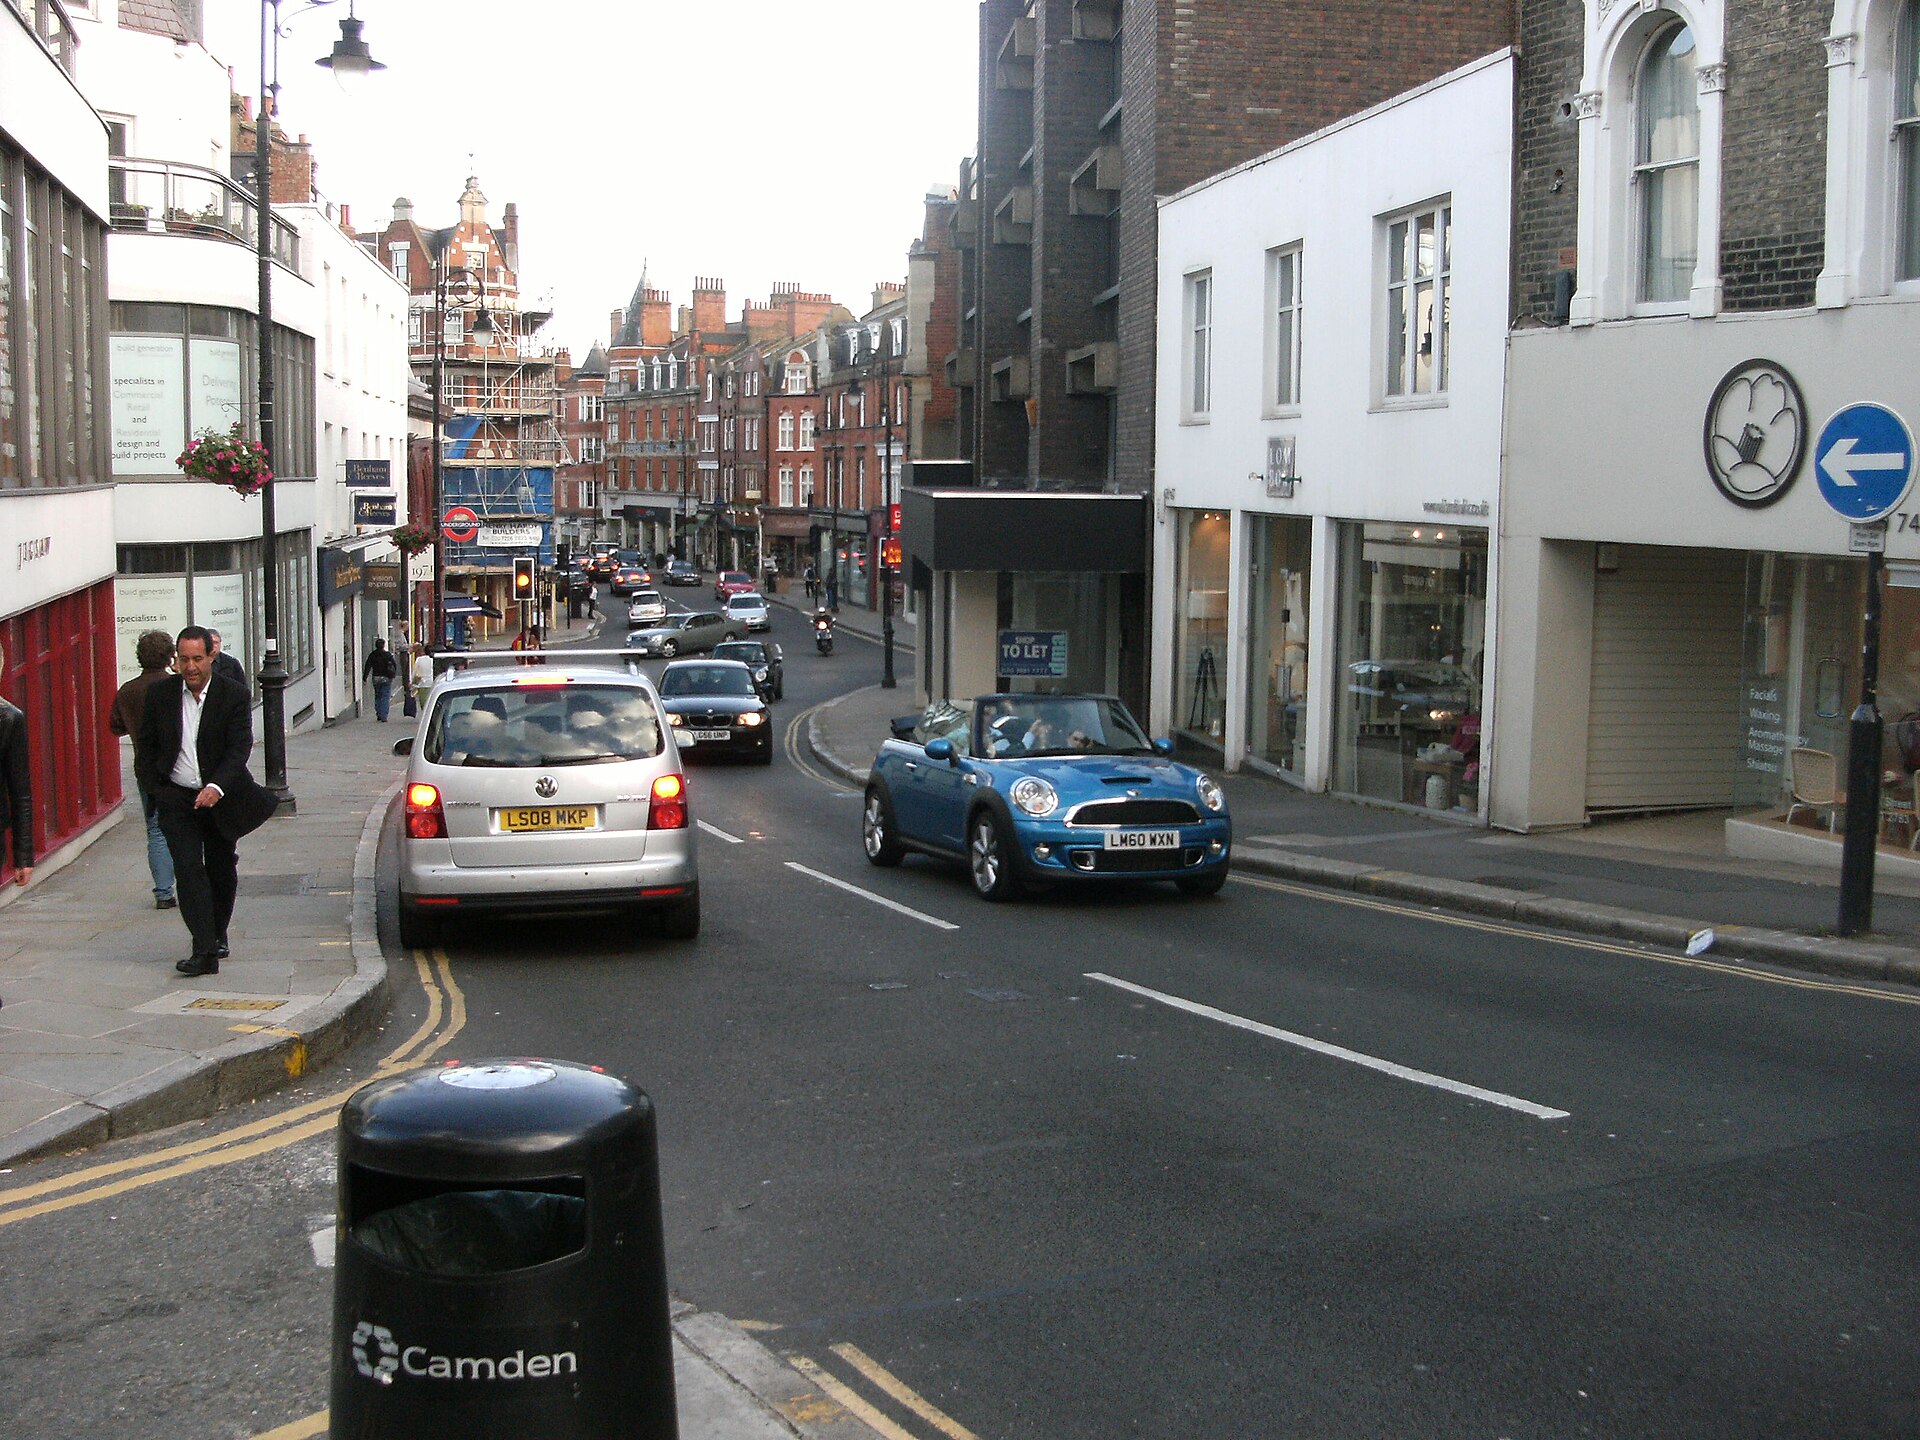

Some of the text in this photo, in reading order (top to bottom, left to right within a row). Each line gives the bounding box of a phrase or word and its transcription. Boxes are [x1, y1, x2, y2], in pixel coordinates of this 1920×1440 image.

[114, 377, 154, 386] specialists
[113, 390, 163, 399] Commercial
[132, 416, 147, 424] and
[117, 440, 143, 449] design
[133, 452, 167, 460] projects
[1898, 513, 1920, 534] 74
[17, 536, 51, 570] JIGSAW
[368, 581, 397, 589] express
[211, 607, 234, 615] specialists
[117, 614, 157, 623] specialists
[1002, 645, 1048, 659] TO LET
[1750, 688, 1777, 702] Facials
[1749, 707, 1780, 723] Waxing
[1748, 727, 1810, 747] Aromatherapy
[1748, 739, 1783, 756] Massage
[1747, 757, 1777, 773] Shiatsu
[507, 809, 589, 827] LS08 MKP
[1110, 832, 1174, 847] LM60 WXN
[401, 1345, 578, 1380] Camden
